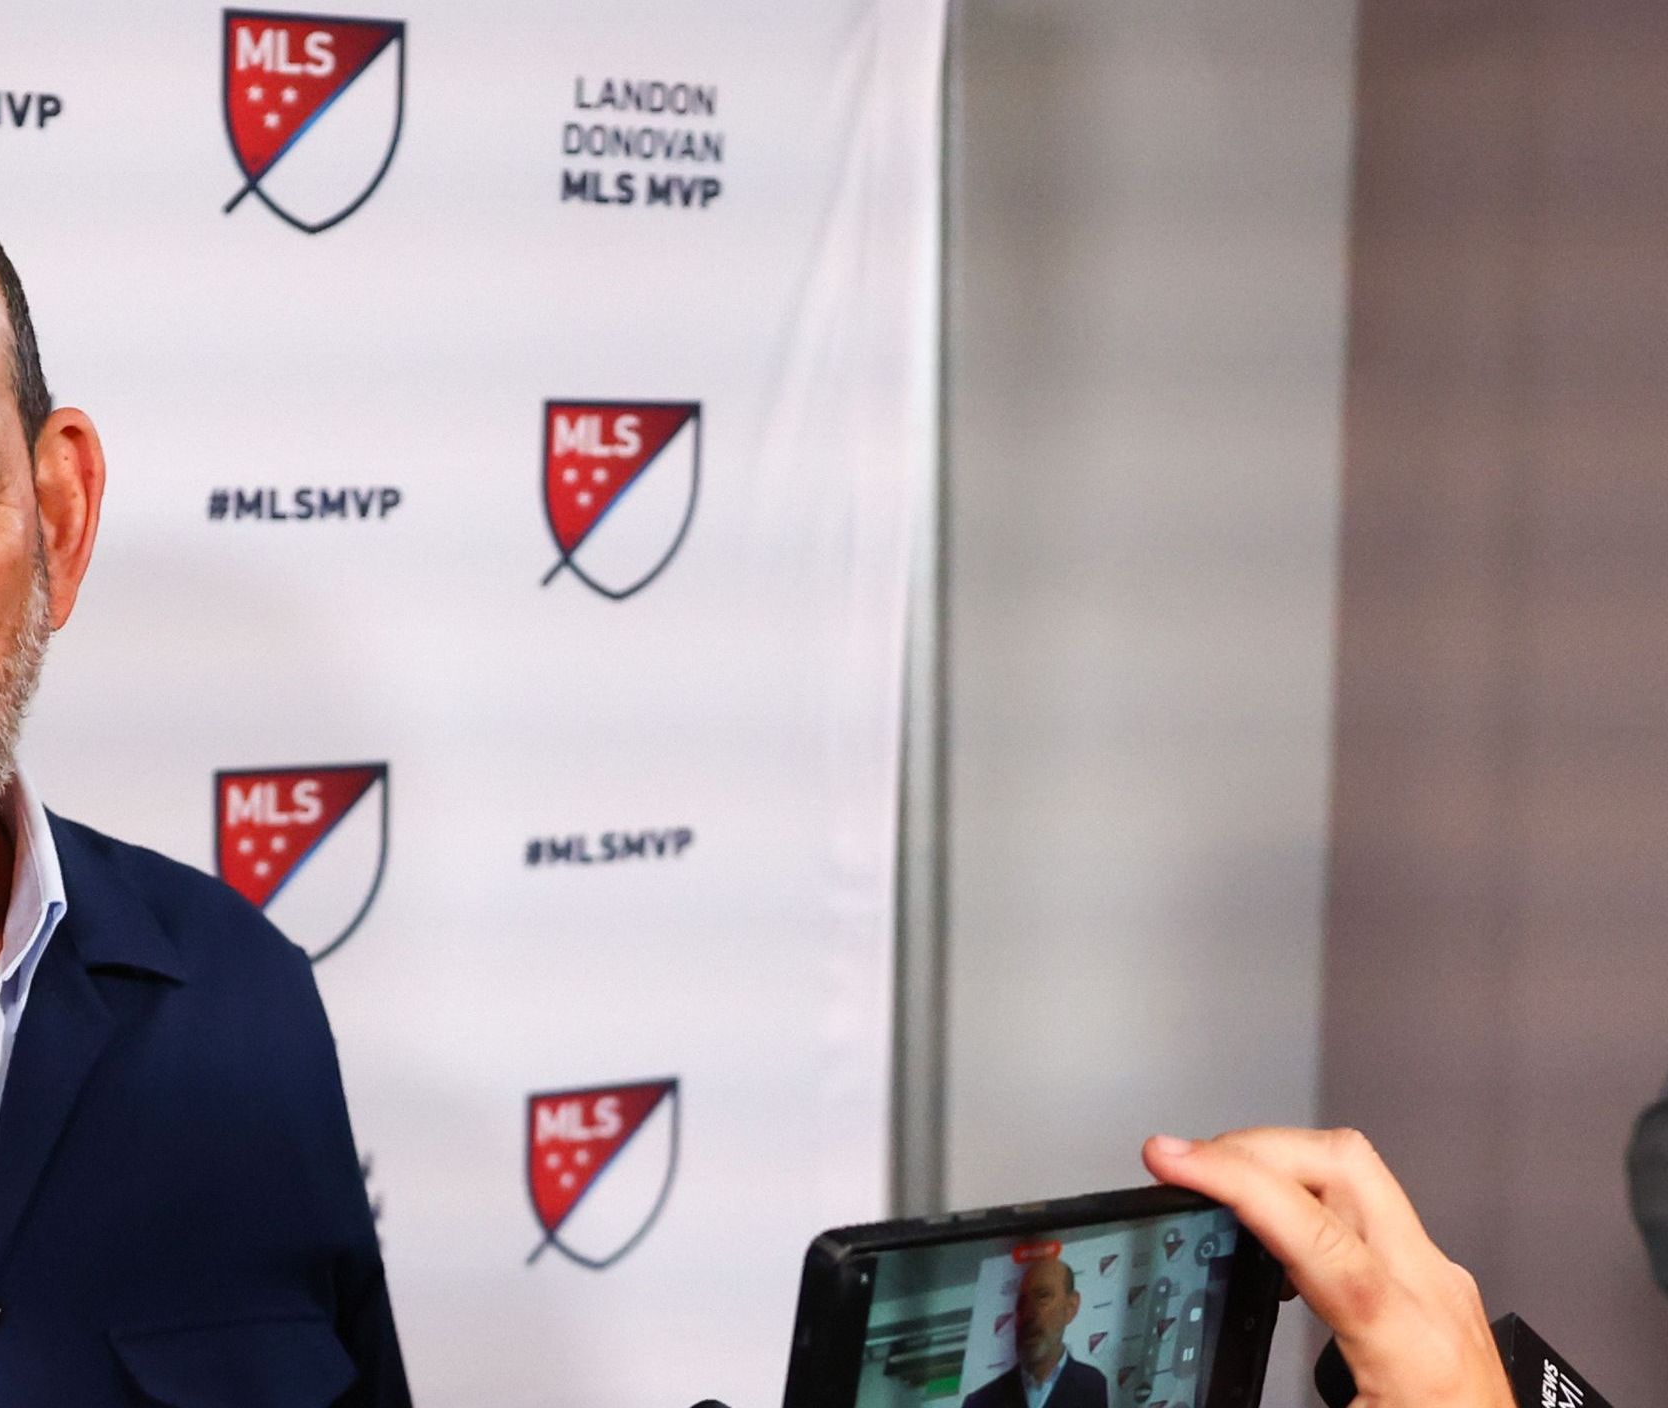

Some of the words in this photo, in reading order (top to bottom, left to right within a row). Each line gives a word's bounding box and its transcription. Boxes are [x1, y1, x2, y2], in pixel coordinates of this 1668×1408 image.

[235, 26, 336, 77] MLS
[574, 76, 716, 116] LANDON
[562, 121, 724, 163] DONOVAN
[561, 170, 636, 206] MLS
[646, 174, 721, 208] MVP
[553, 414, 642, 458] MLS
[208, 487, 403, 521] #MLSMVP
[226, 779, 323, 827] MLS
[525, 827, 694, 867] #MLSMVP
[536, 1096, 622, 1144] MLS
